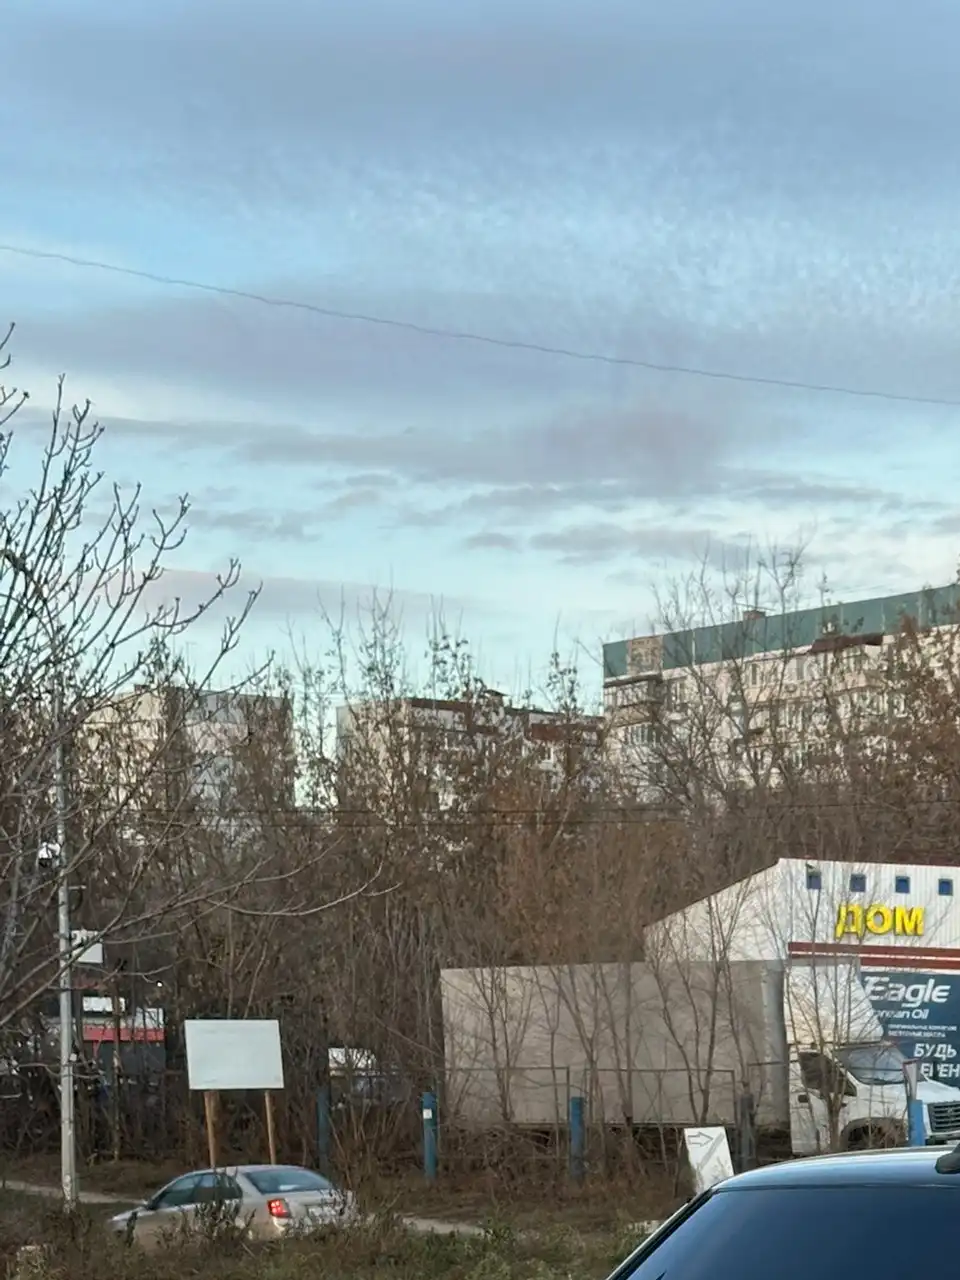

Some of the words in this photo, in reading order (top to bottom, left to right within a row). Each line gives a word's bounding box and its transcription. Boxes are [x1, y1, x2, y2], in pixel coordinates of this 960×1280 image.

[835, 903, 926, 940] ДОМ
[864, 976, 951, 1008] Eagle
[914, 1043, 957, 1060] БУДЬ
